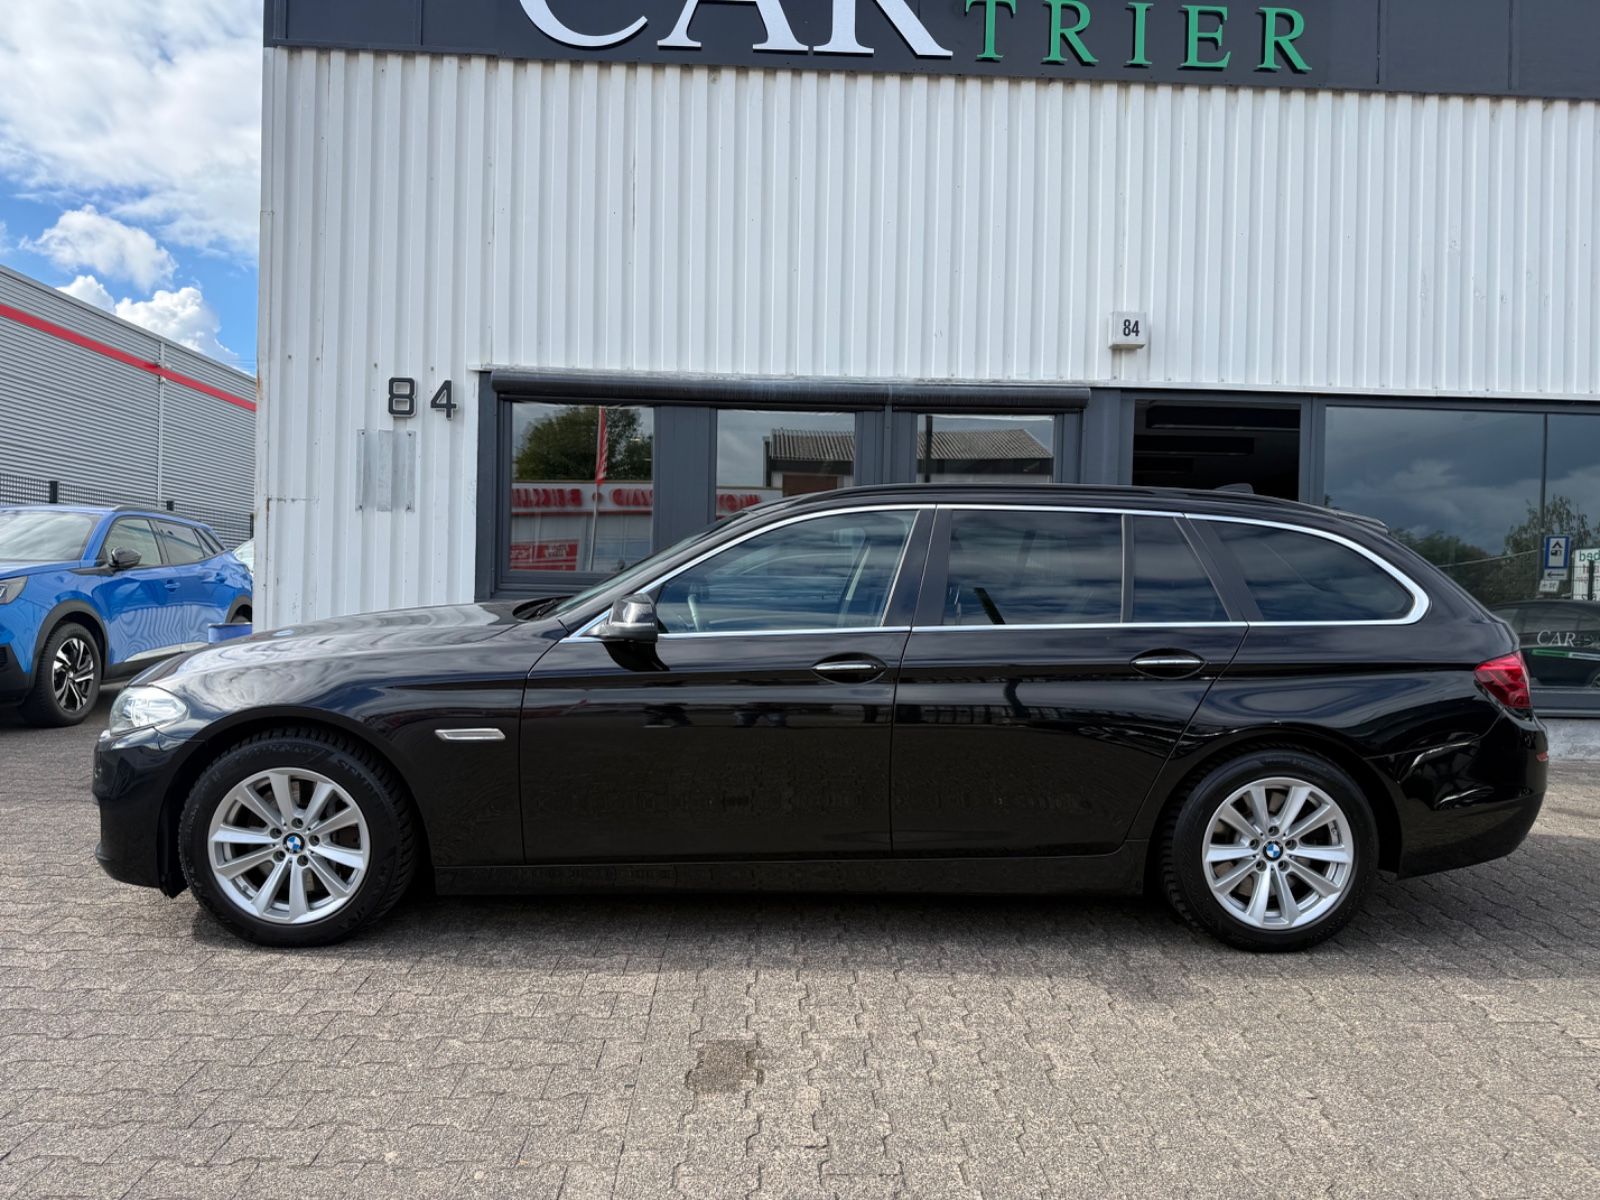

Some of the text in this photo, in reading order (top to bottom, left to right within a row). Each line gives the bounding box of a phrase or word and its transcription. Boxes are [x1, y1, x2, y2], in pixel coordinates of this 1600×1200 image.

[965, 0, 1312, 71] TRIER
[1123, 319, 1140, 337] 84
[1537, 630, 1575, 647] CAR
